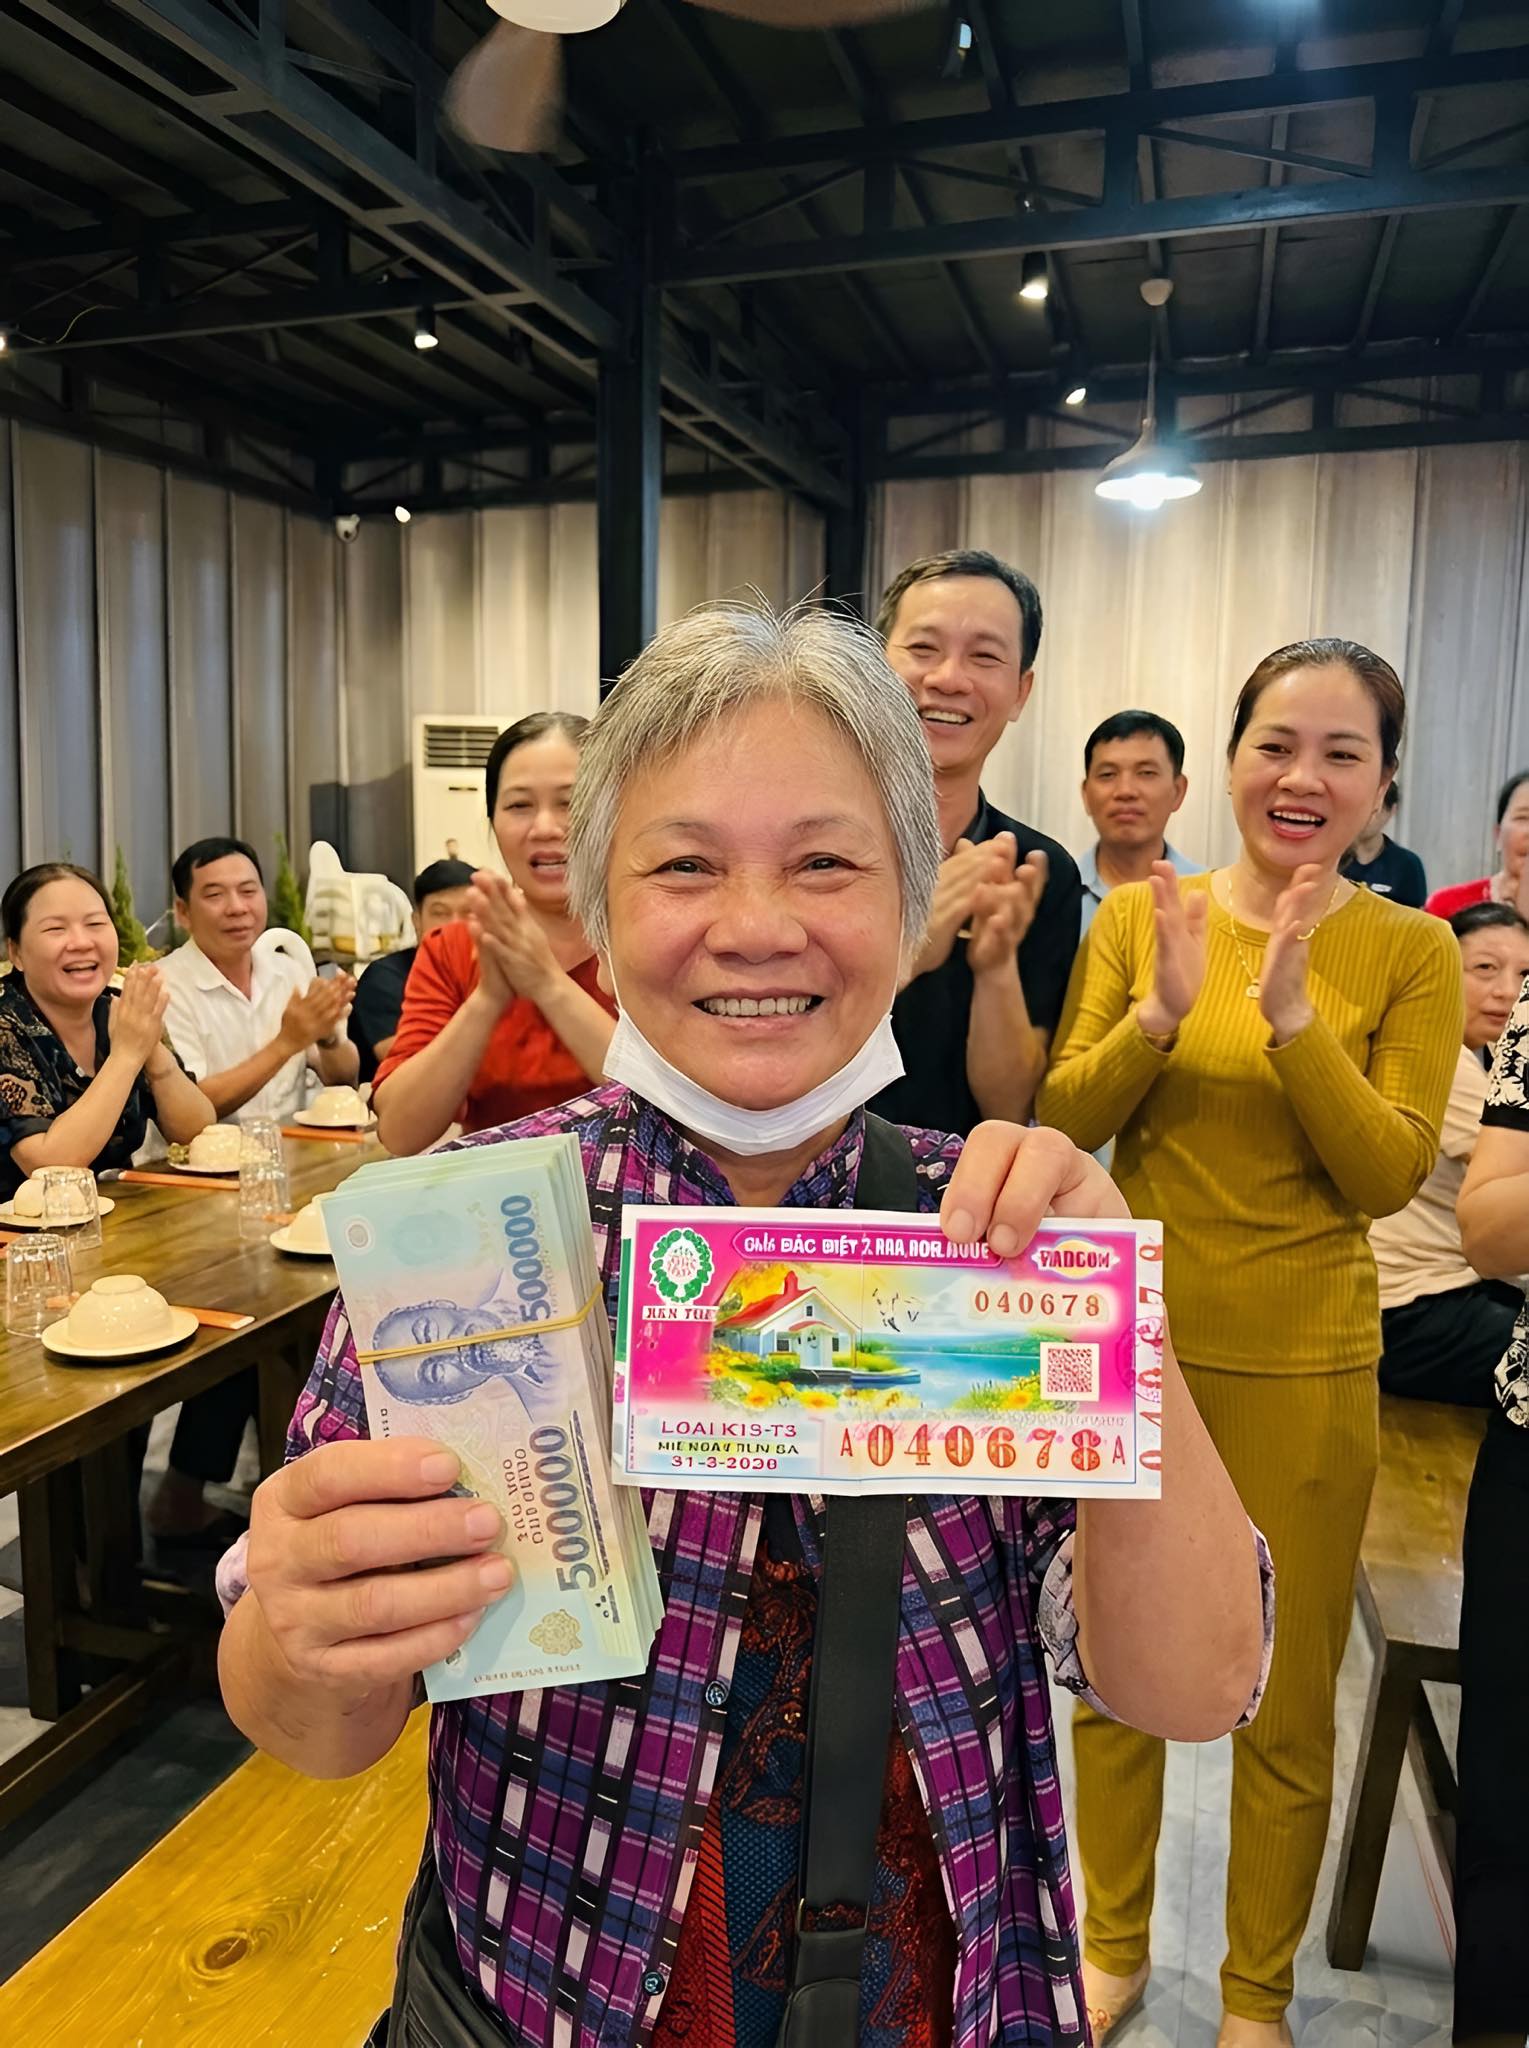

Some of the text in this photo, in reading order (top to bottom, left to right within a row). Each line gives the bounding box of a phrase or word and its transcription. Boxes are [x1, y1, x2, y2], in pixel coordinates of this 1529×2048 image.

[500, 1195, 551, 1321] 500000
[974, 1289, 1100, 1317] 040678
[840, 1424, 1126, 1471] A 040678 A
[529, 1425, 597, 1591] 500000
